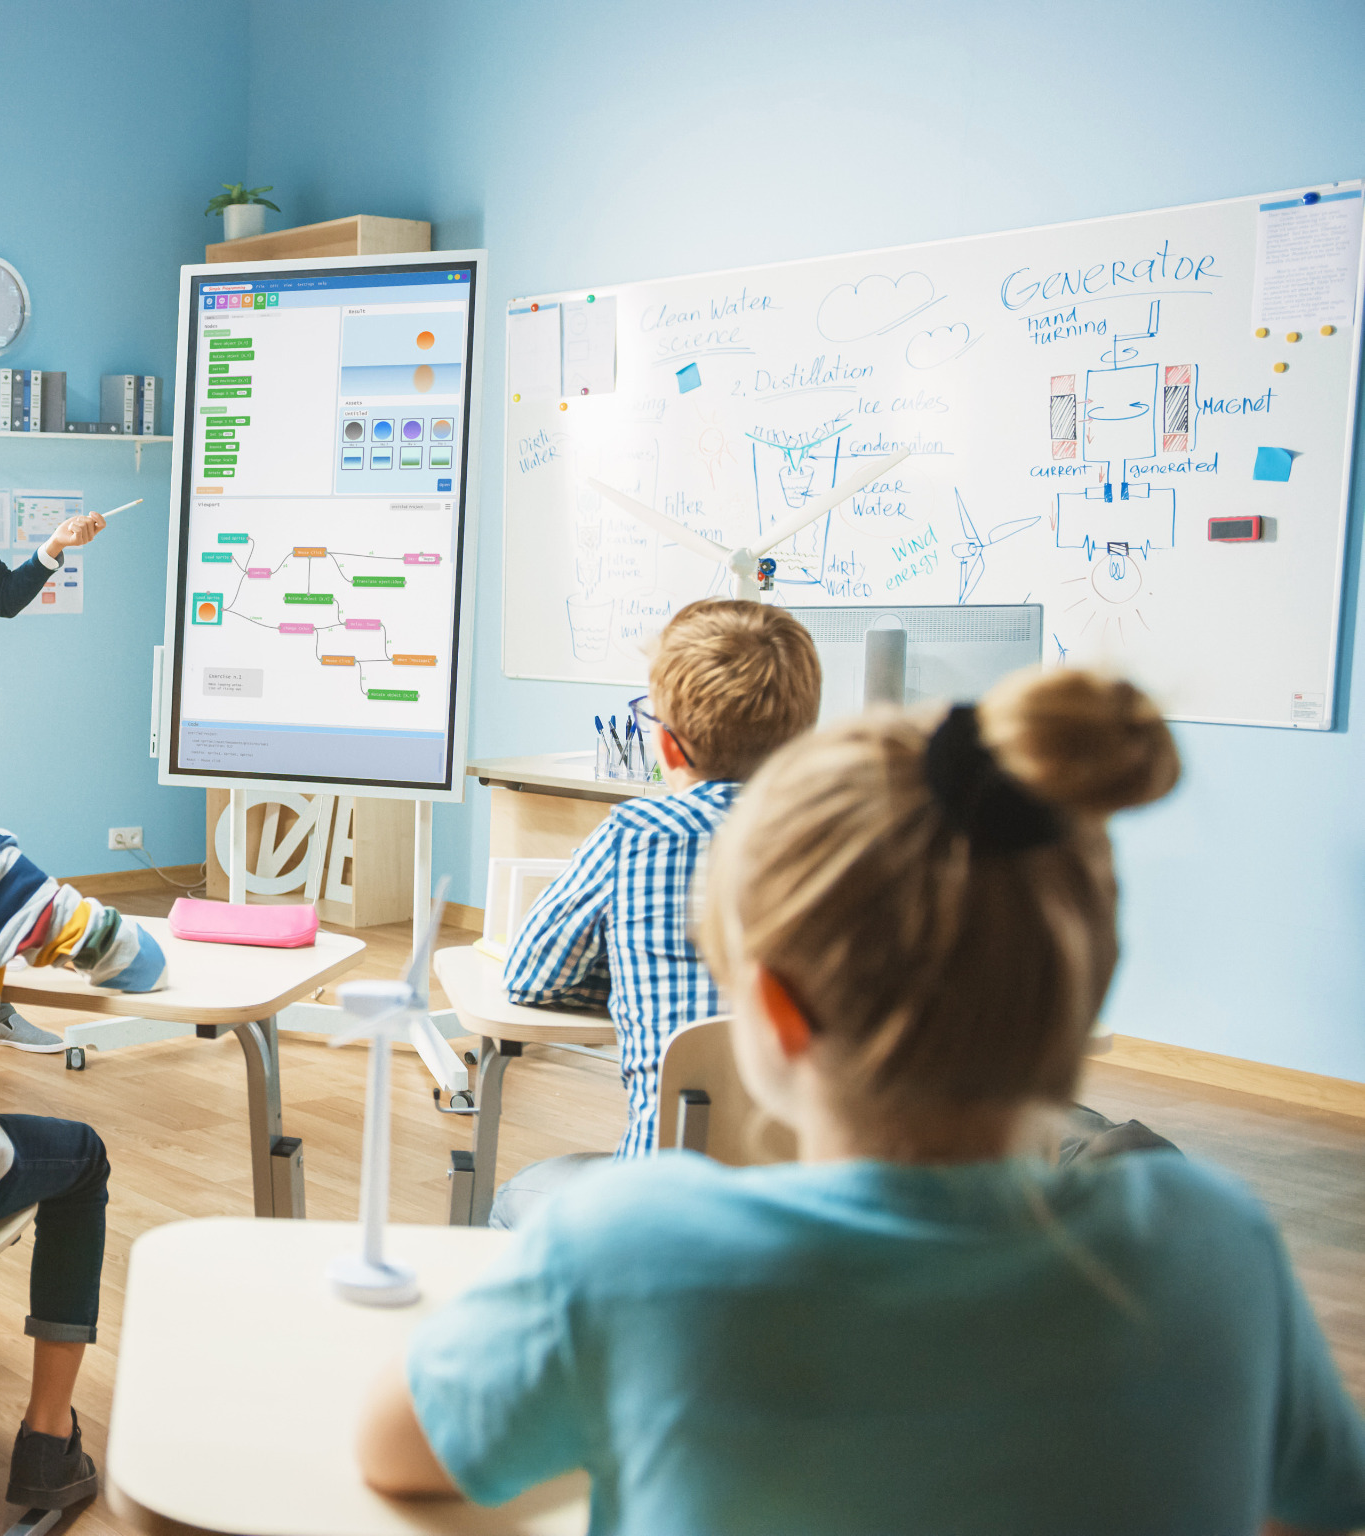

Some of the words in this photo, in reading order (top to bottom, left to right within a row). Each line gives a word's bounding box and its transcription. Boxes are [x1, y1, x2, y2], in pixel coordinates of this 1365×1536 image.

[1001, 239, 1223, 310] Generator
[639, 304, 700, 332] Clean
[711, 287, 783, 320] Water
[1027, 307, 1077, 332] hand
[656, 327, 744, 356] science
[1030, 319, 1107, 344] turning
[754, 354, 874, 392] Distillation
[858, 397, 883, 414] Ice
[1202, 387, 1278, 416] Magnet
[1030, 464, 1093, 478] current
[1130, 452, 1219, 478] generated
[886, 549, 939, 591] energy
